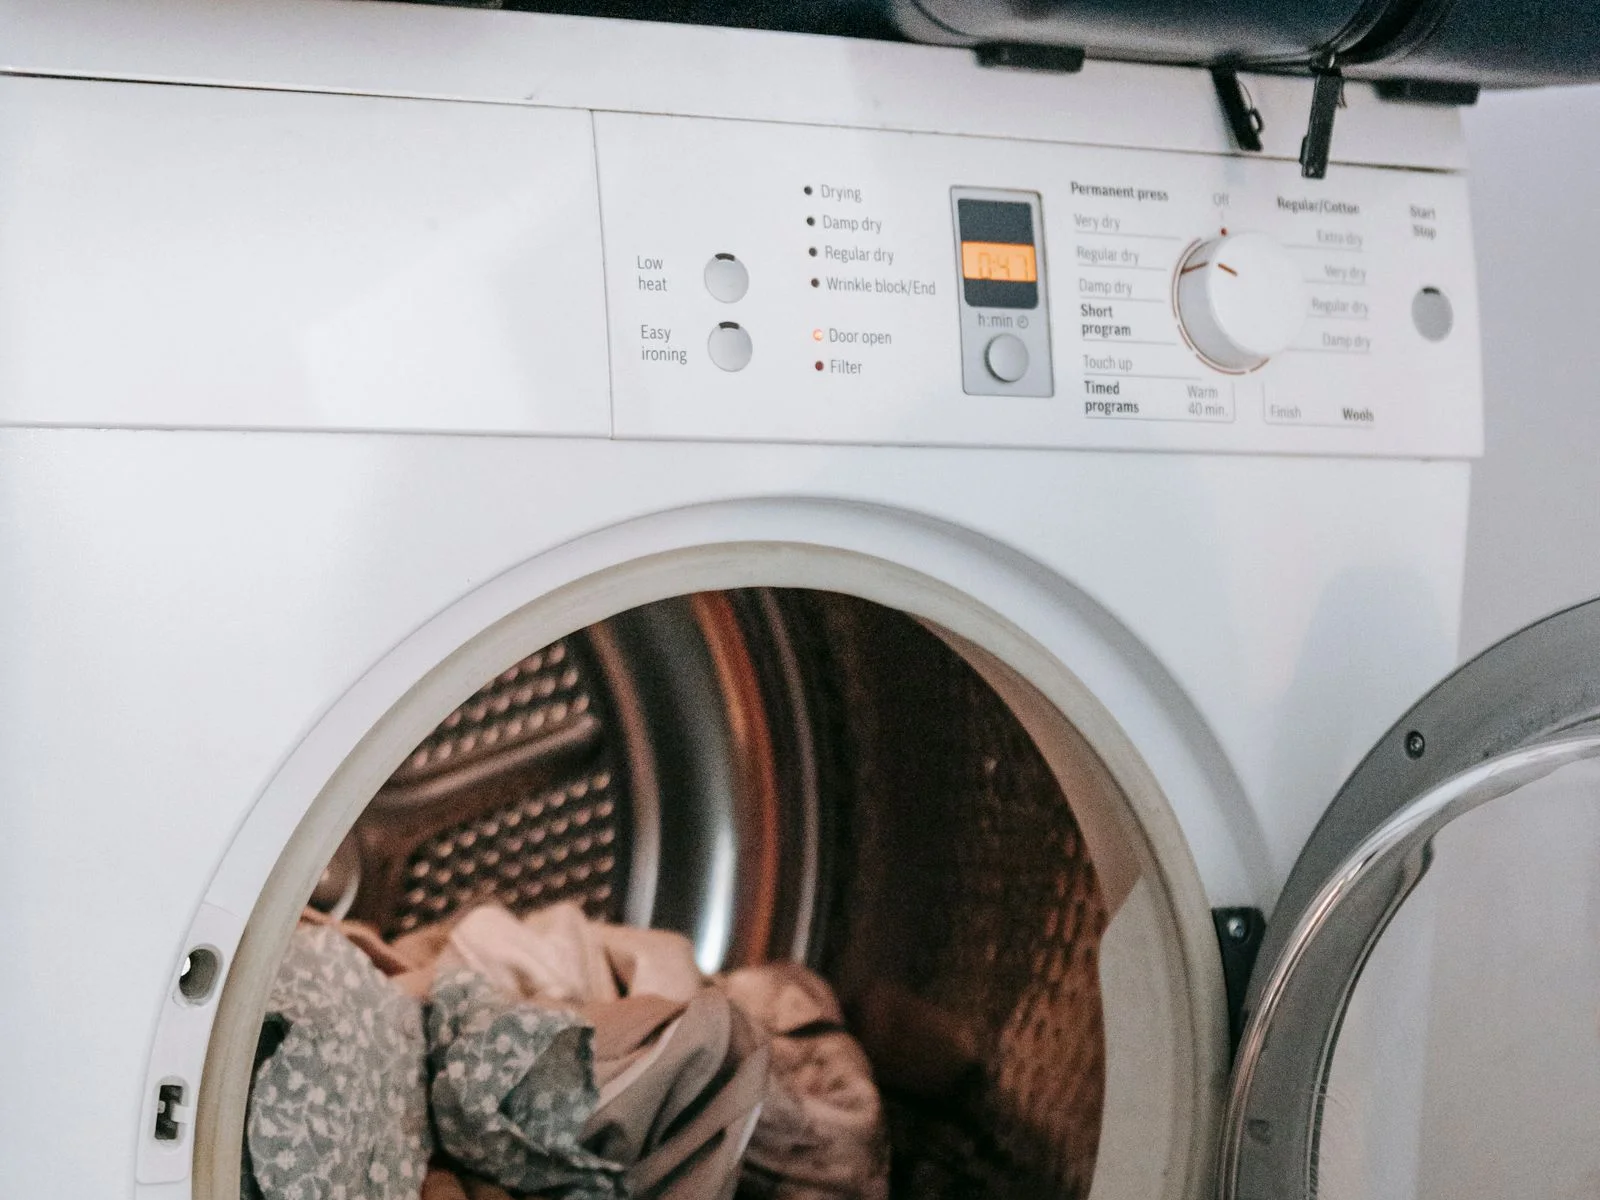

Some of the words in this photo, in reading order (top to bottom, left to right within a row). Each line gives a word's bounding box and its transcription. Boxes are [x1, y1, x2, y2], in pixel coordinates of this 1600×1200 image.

[821, 184, 862, 203] Drying
[1070, 181, 1135, 198] Permanent
[1137, 190, 1168, 202] press
[1410, 205, 1436, 220] Start
[822, 215, 858, 233] Damp
[862, 217, 882, 235] dry
[1074, 213, 1099, 231] Very
[1102, 214, 1120, 231] dry
[1347, 232, 1364, 249] dry
[1413, 223, 1437, 240] Stop
[637, 256, 663, 270] Low
[825, 246, 871, 265] Regular
[874, 248, 894, 266] dry
[1076, 245, 1118, 262] Regular
[1121, 247, 1140, 264] dry
[1324, 264, 1346, 281] Very
[1349, 267, 1367, 283] dry
[638, 276, 667, 292] heat
[826, 277, 872, 294] Wrinkle
[875, 279, 936, 297] block/End
[1078, 277, 1112, 294] Damp
[1116, 280, 1133, 296] dry
[1080, 303, 1113, 318] Short
[1311, 296, 1350, 314] Regular
[1352, 299, 1369, 315] dry
[978, 313, 1014, 328] h:min
[641, 324, 671, 343] Easy
[828, 328, 859, 345] Door
[862, 331, 892, 350] open
[1082, 324, 1132, 338] program
[1322, 332, 1351, 348] Damp
[1354, 335, 1372, 350] dry
[641, 346, 687, 365] ironing
[1083, 354, 1116, 370] Touch
[1118, 358, 1133, 372] up
[830, 359, 863, 375] Filter
[1084, 380, 1120, 395] Timed
[1186, 384, 1218, 400] Warm
[1085, 400, 1140, 416] programs
[1188, 403, 1203, 416] 40
[1270, 404, 1302, 419] Finish
